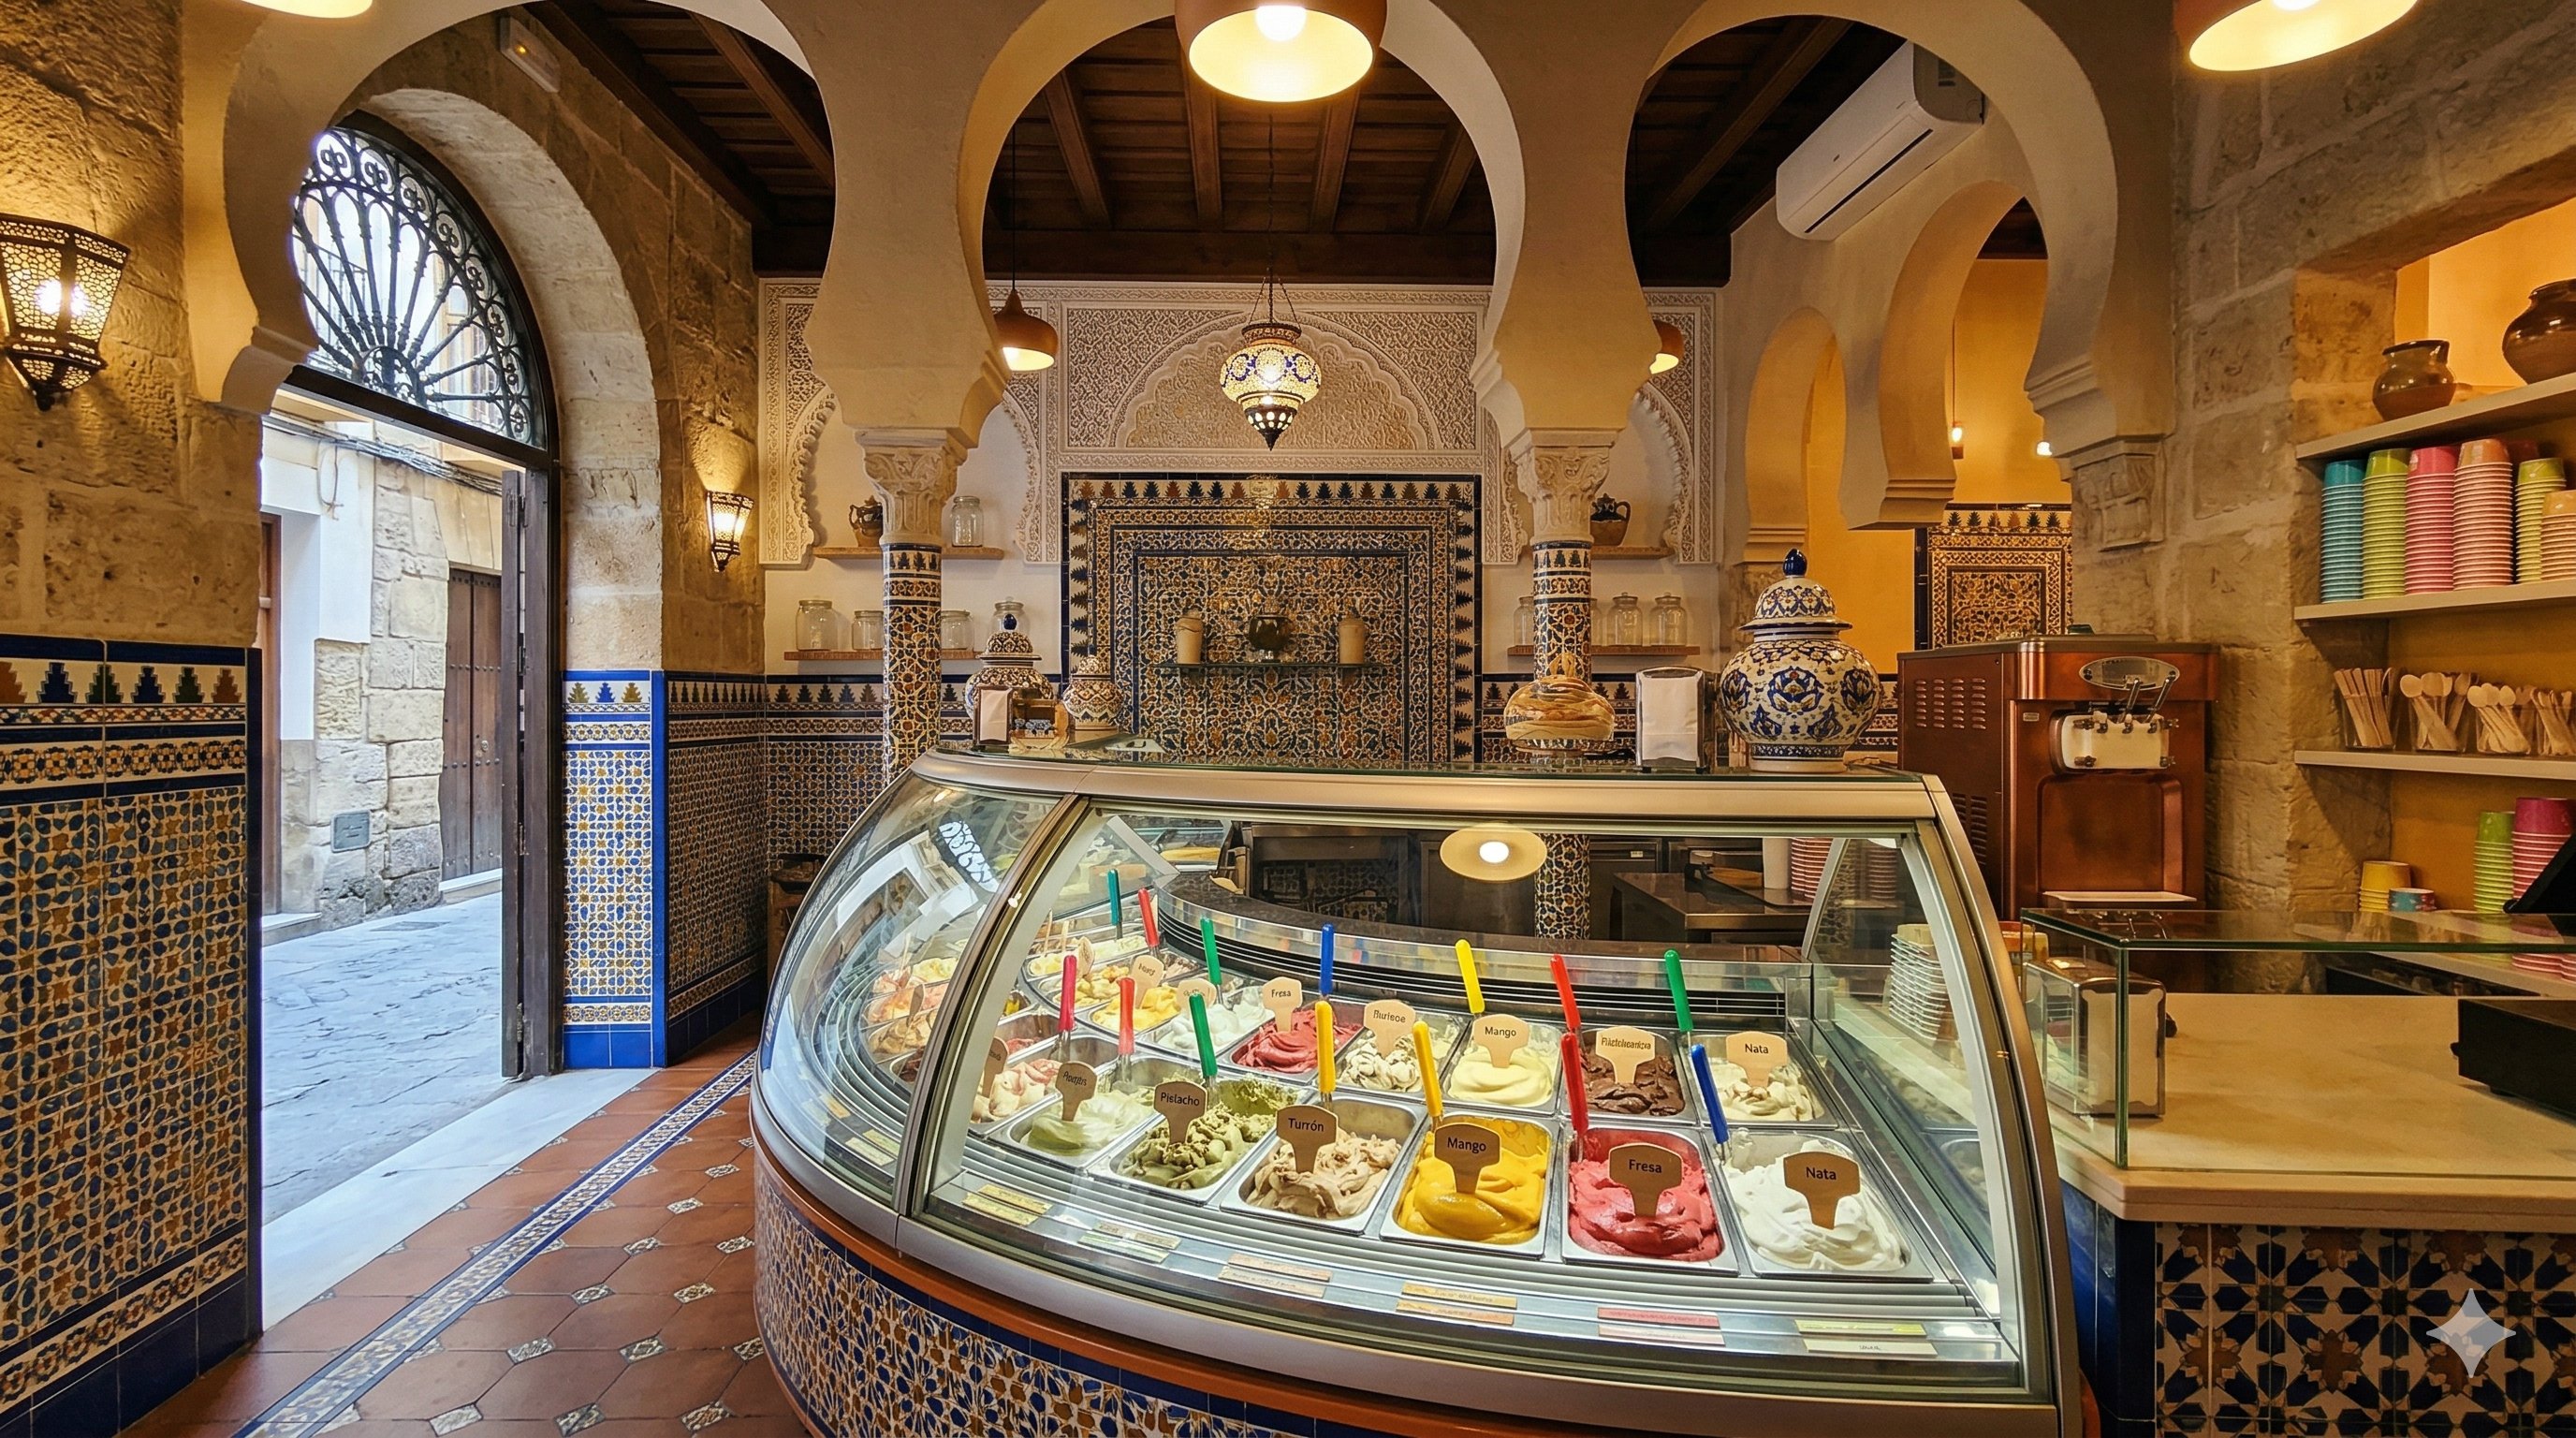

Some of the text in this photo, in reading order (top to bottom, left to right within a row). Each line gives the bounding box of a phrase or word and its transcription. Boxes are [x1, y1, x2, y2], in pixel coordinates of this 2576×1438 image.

[1485, 1026, 1516, 1038] Mango
[1745, 1043, 1769, 1054] Nata
[1288, 1118, 1325, 1132] Turrón
[1447, 1137, 1486, 1154] Mango
[1629, 1159, 1662, 1173] Fresa
[1806, 1167, 1837, 1181] Nata
